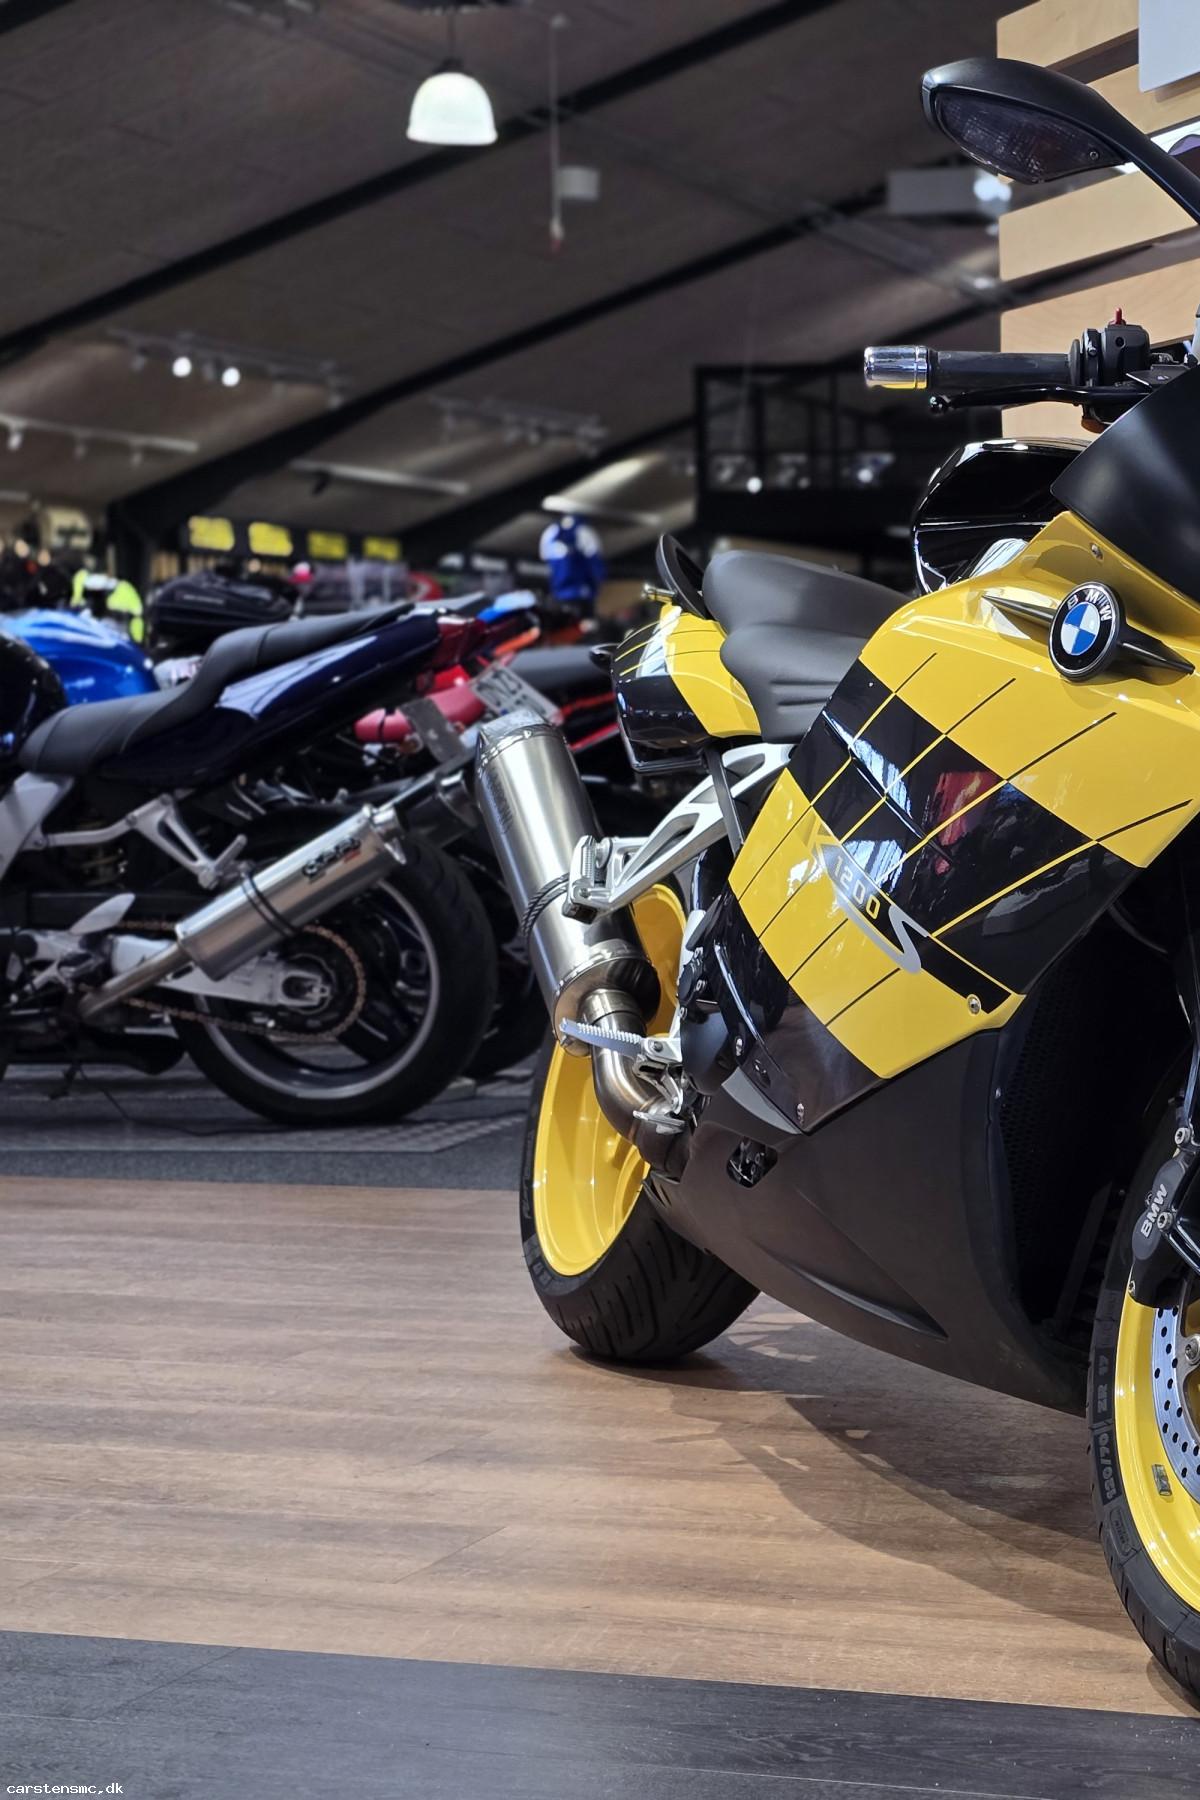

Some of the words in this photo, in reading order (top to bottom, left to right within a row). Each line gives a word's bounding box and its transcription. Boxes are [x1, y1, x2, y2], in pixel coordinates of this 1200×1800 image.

[1067, 588, 1113, 621] BMW
[834, 855, 881, 920] 1200
[1140, 1183, 1168, 1238] BMW
[1099, 1432, 1117, 1500] 120/70
